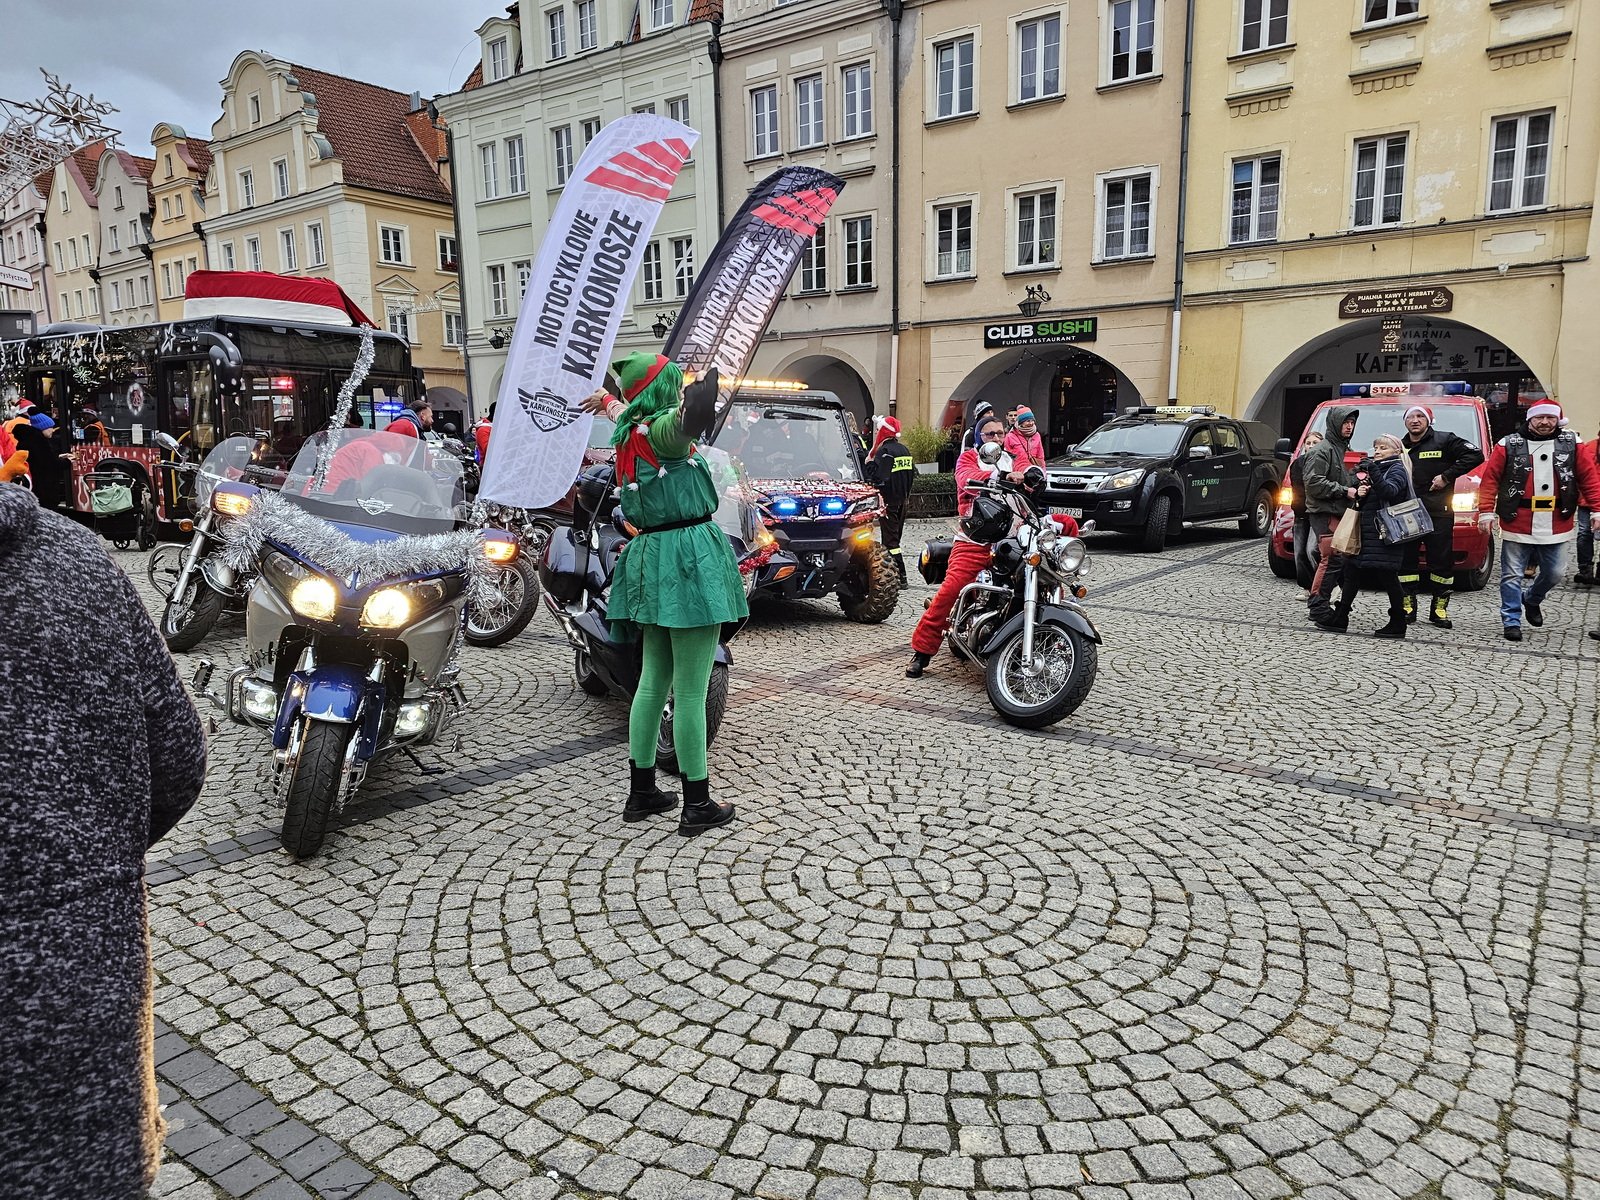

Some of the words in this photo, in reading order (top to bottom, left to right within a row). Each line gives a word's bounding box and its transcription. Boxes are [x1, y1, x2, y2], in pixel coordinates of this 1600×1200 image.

[534, 209, 599, 348] MOTOCYKLOWE
[691, 236, 760, 349] MOTOCYKLOWE
[561, 209, 643, 380] KARKONOSZE
[710, 238, 795, 380] KARKONOSZE
[987, 325, 1034, 340] CLUB
[1037, 320, 1093, 336] SUSHI
[1029, 335, 1076, 344] RESTAURANT
[1355, 352, 1442, 374] KAFFEE
[1475, 345, 1521, 369] TEE
[1372, 384, 1409, 394] STRAŻ
[530, 401, 568, 420] KARKONOSZE
